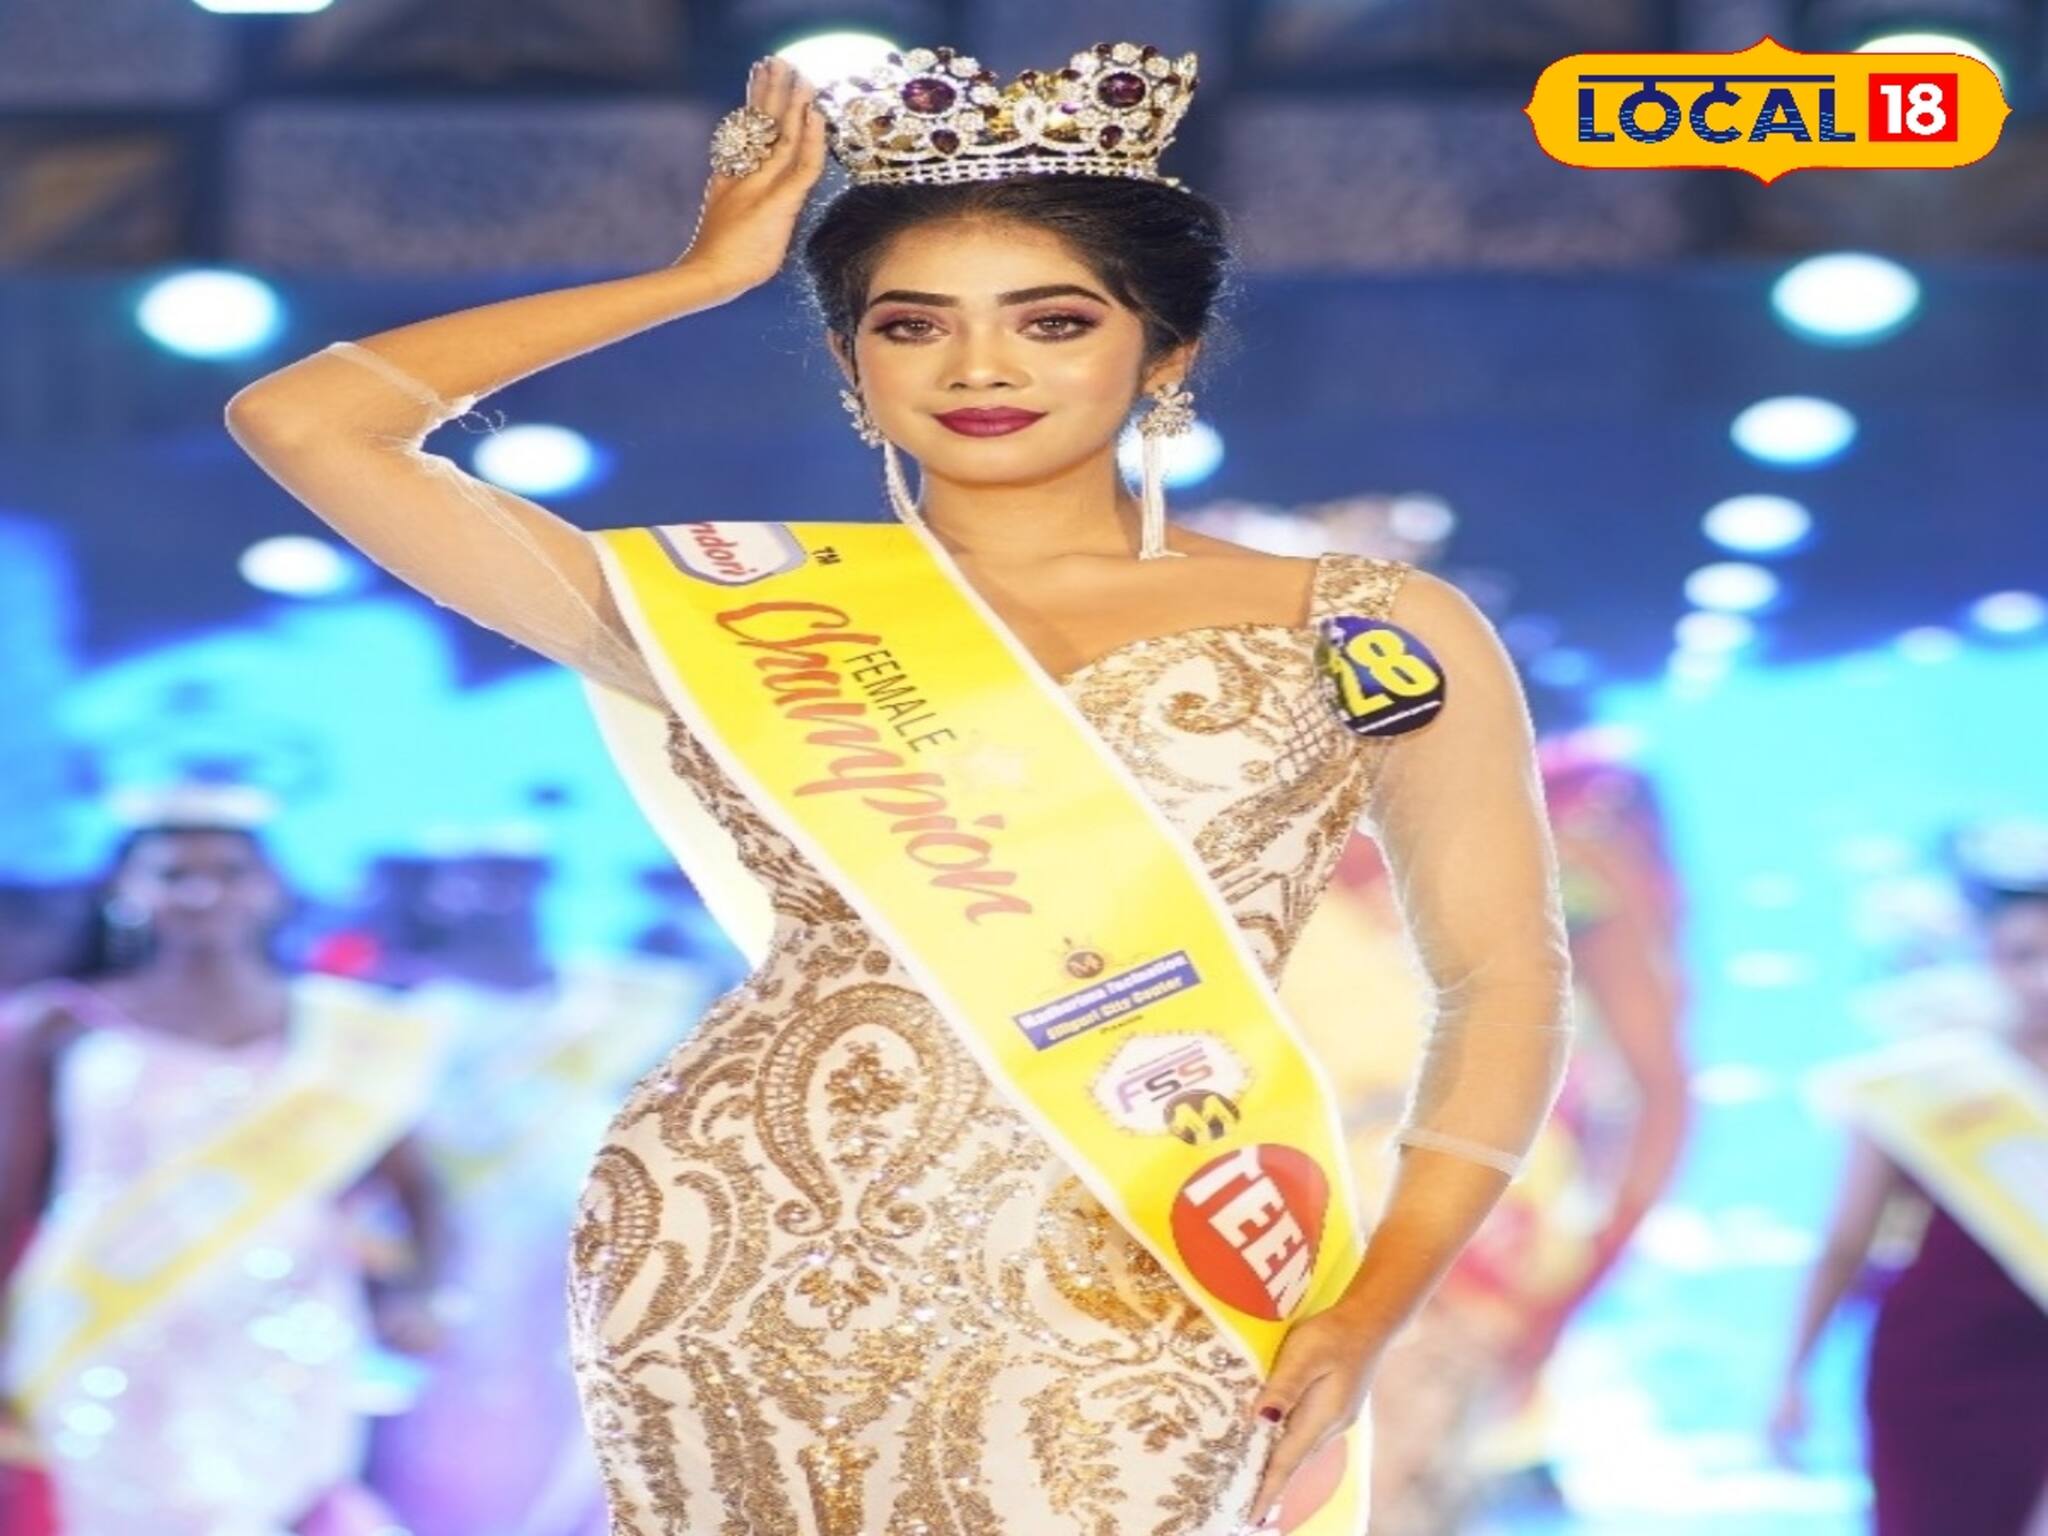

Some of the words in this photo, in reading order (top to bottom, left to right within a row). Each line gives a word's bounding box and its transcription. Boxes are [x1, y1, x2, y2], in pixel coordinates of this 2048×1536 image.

[812, 546, 842, 567] TM
[843, 649, 958, 753] FEMALE
[1327, 629, 1440, 717] 28
[715, 600, 1033, 924] Champion
[1184, 1145, 1312, 1320] TEEN
